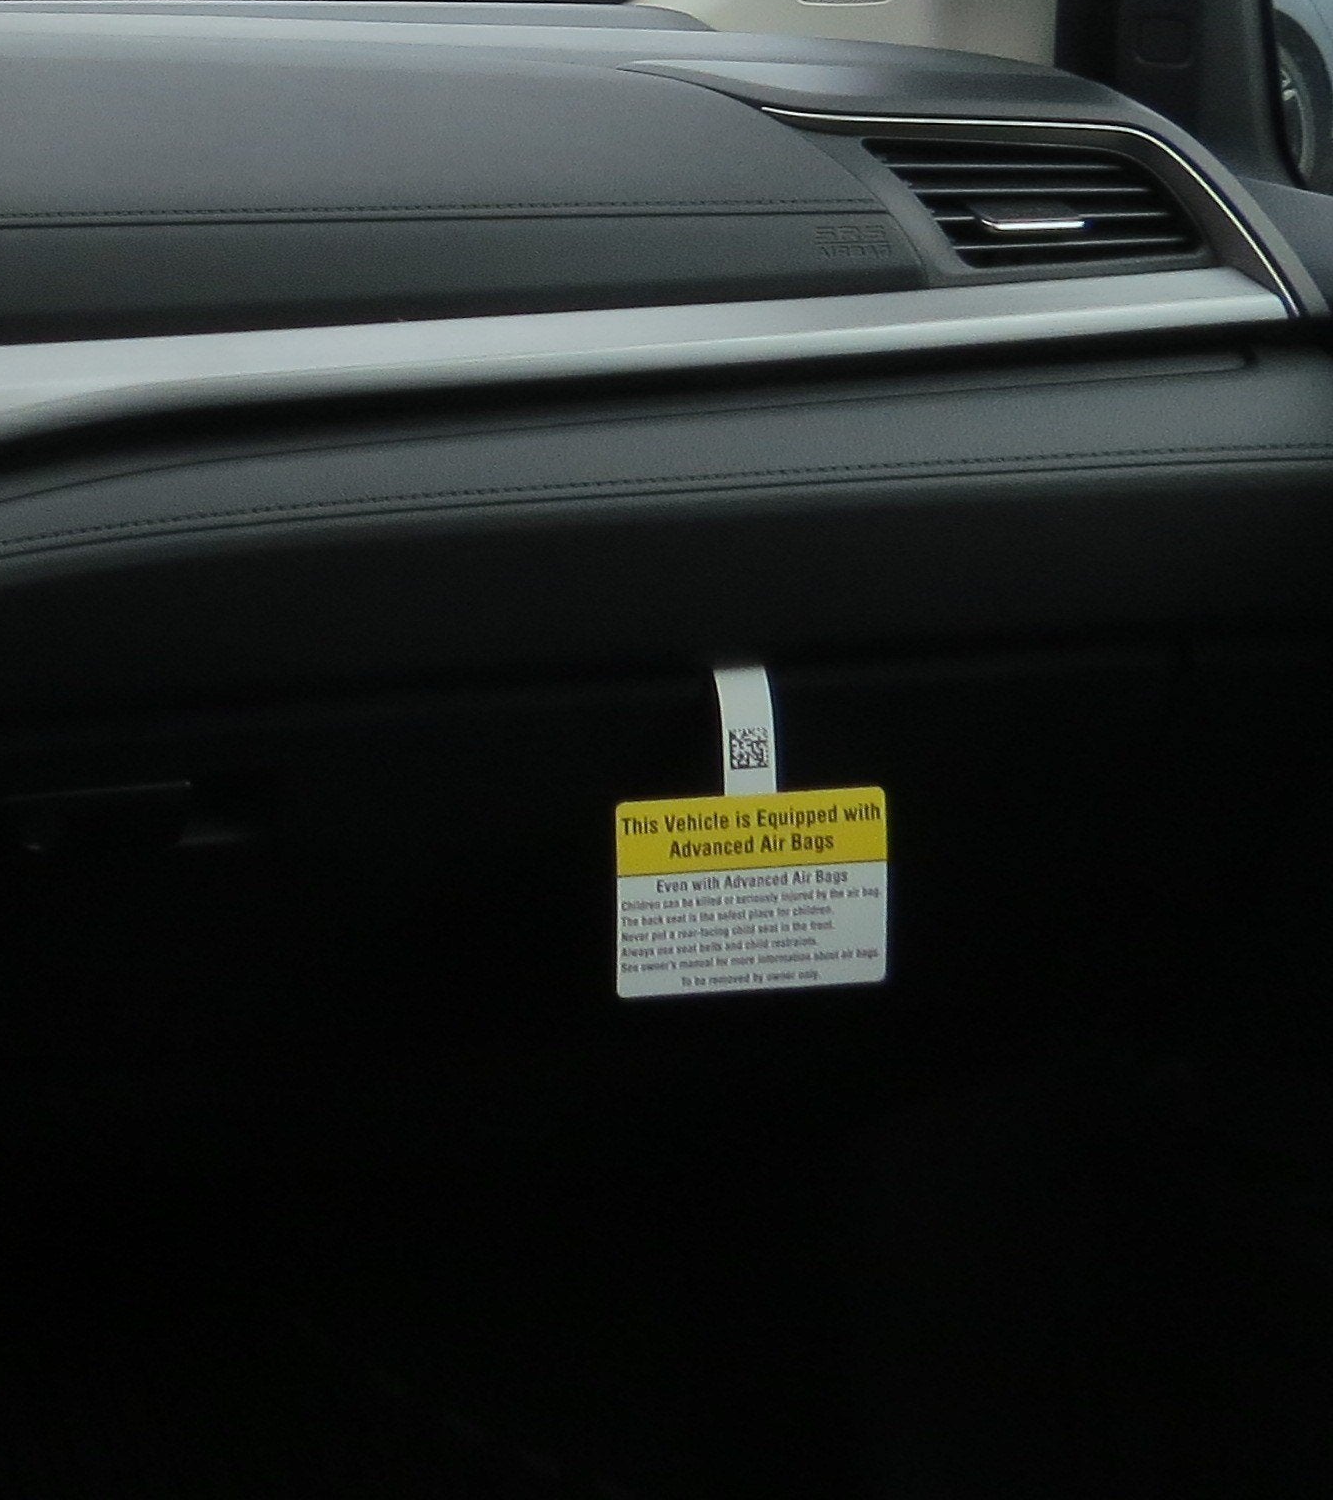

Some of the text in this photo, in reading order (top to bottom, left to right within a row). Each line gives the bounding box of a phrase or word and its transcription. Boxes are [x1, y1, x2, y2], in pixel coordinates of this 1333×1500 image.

[622, 802, 882, 835] This Vehicle is Equipped with
[668, 832, 835, 859] Advanced Air Bags
[656, 869, 848, 894] Even with Advanced Air Bags
